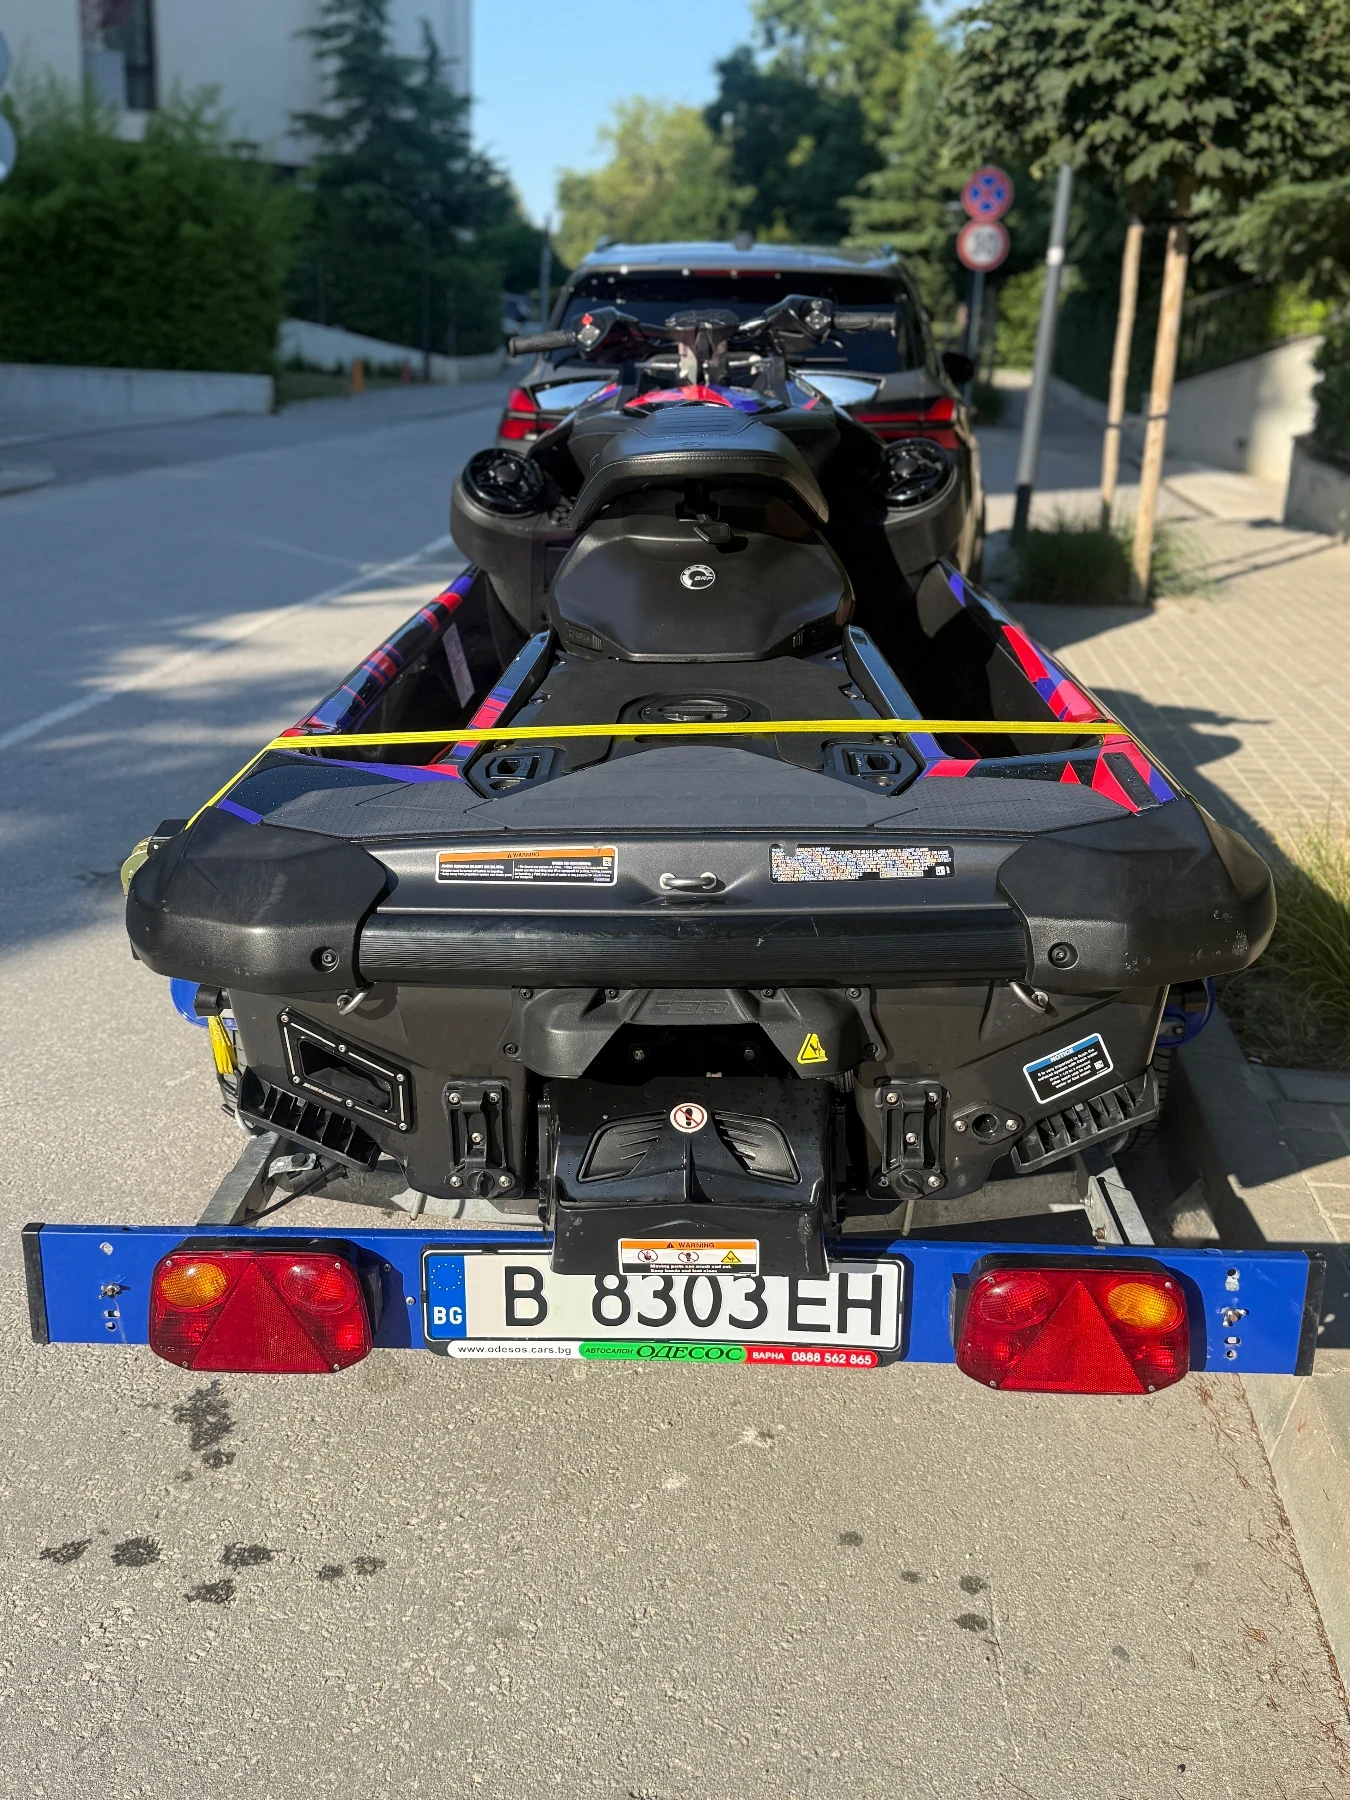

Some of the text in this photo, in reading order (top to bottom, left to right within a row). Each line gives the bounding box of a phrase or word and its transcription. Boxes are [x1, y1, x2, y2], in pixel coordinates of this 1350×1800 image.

[1050, 1048, 1074, 1062] NOTICE
[505, 1266, 882, 1335] B 8303 EH
[434, 1306, 462, 1325] BG
[458, 1345, 572, 1356] www.odesos.cars.bg
[636, 1345, 744, 1360] ОДЕСОС
[753, 1351, 785, 1360] ВАРНА
[791, 1352, 872, 1365] 0888 562 865
